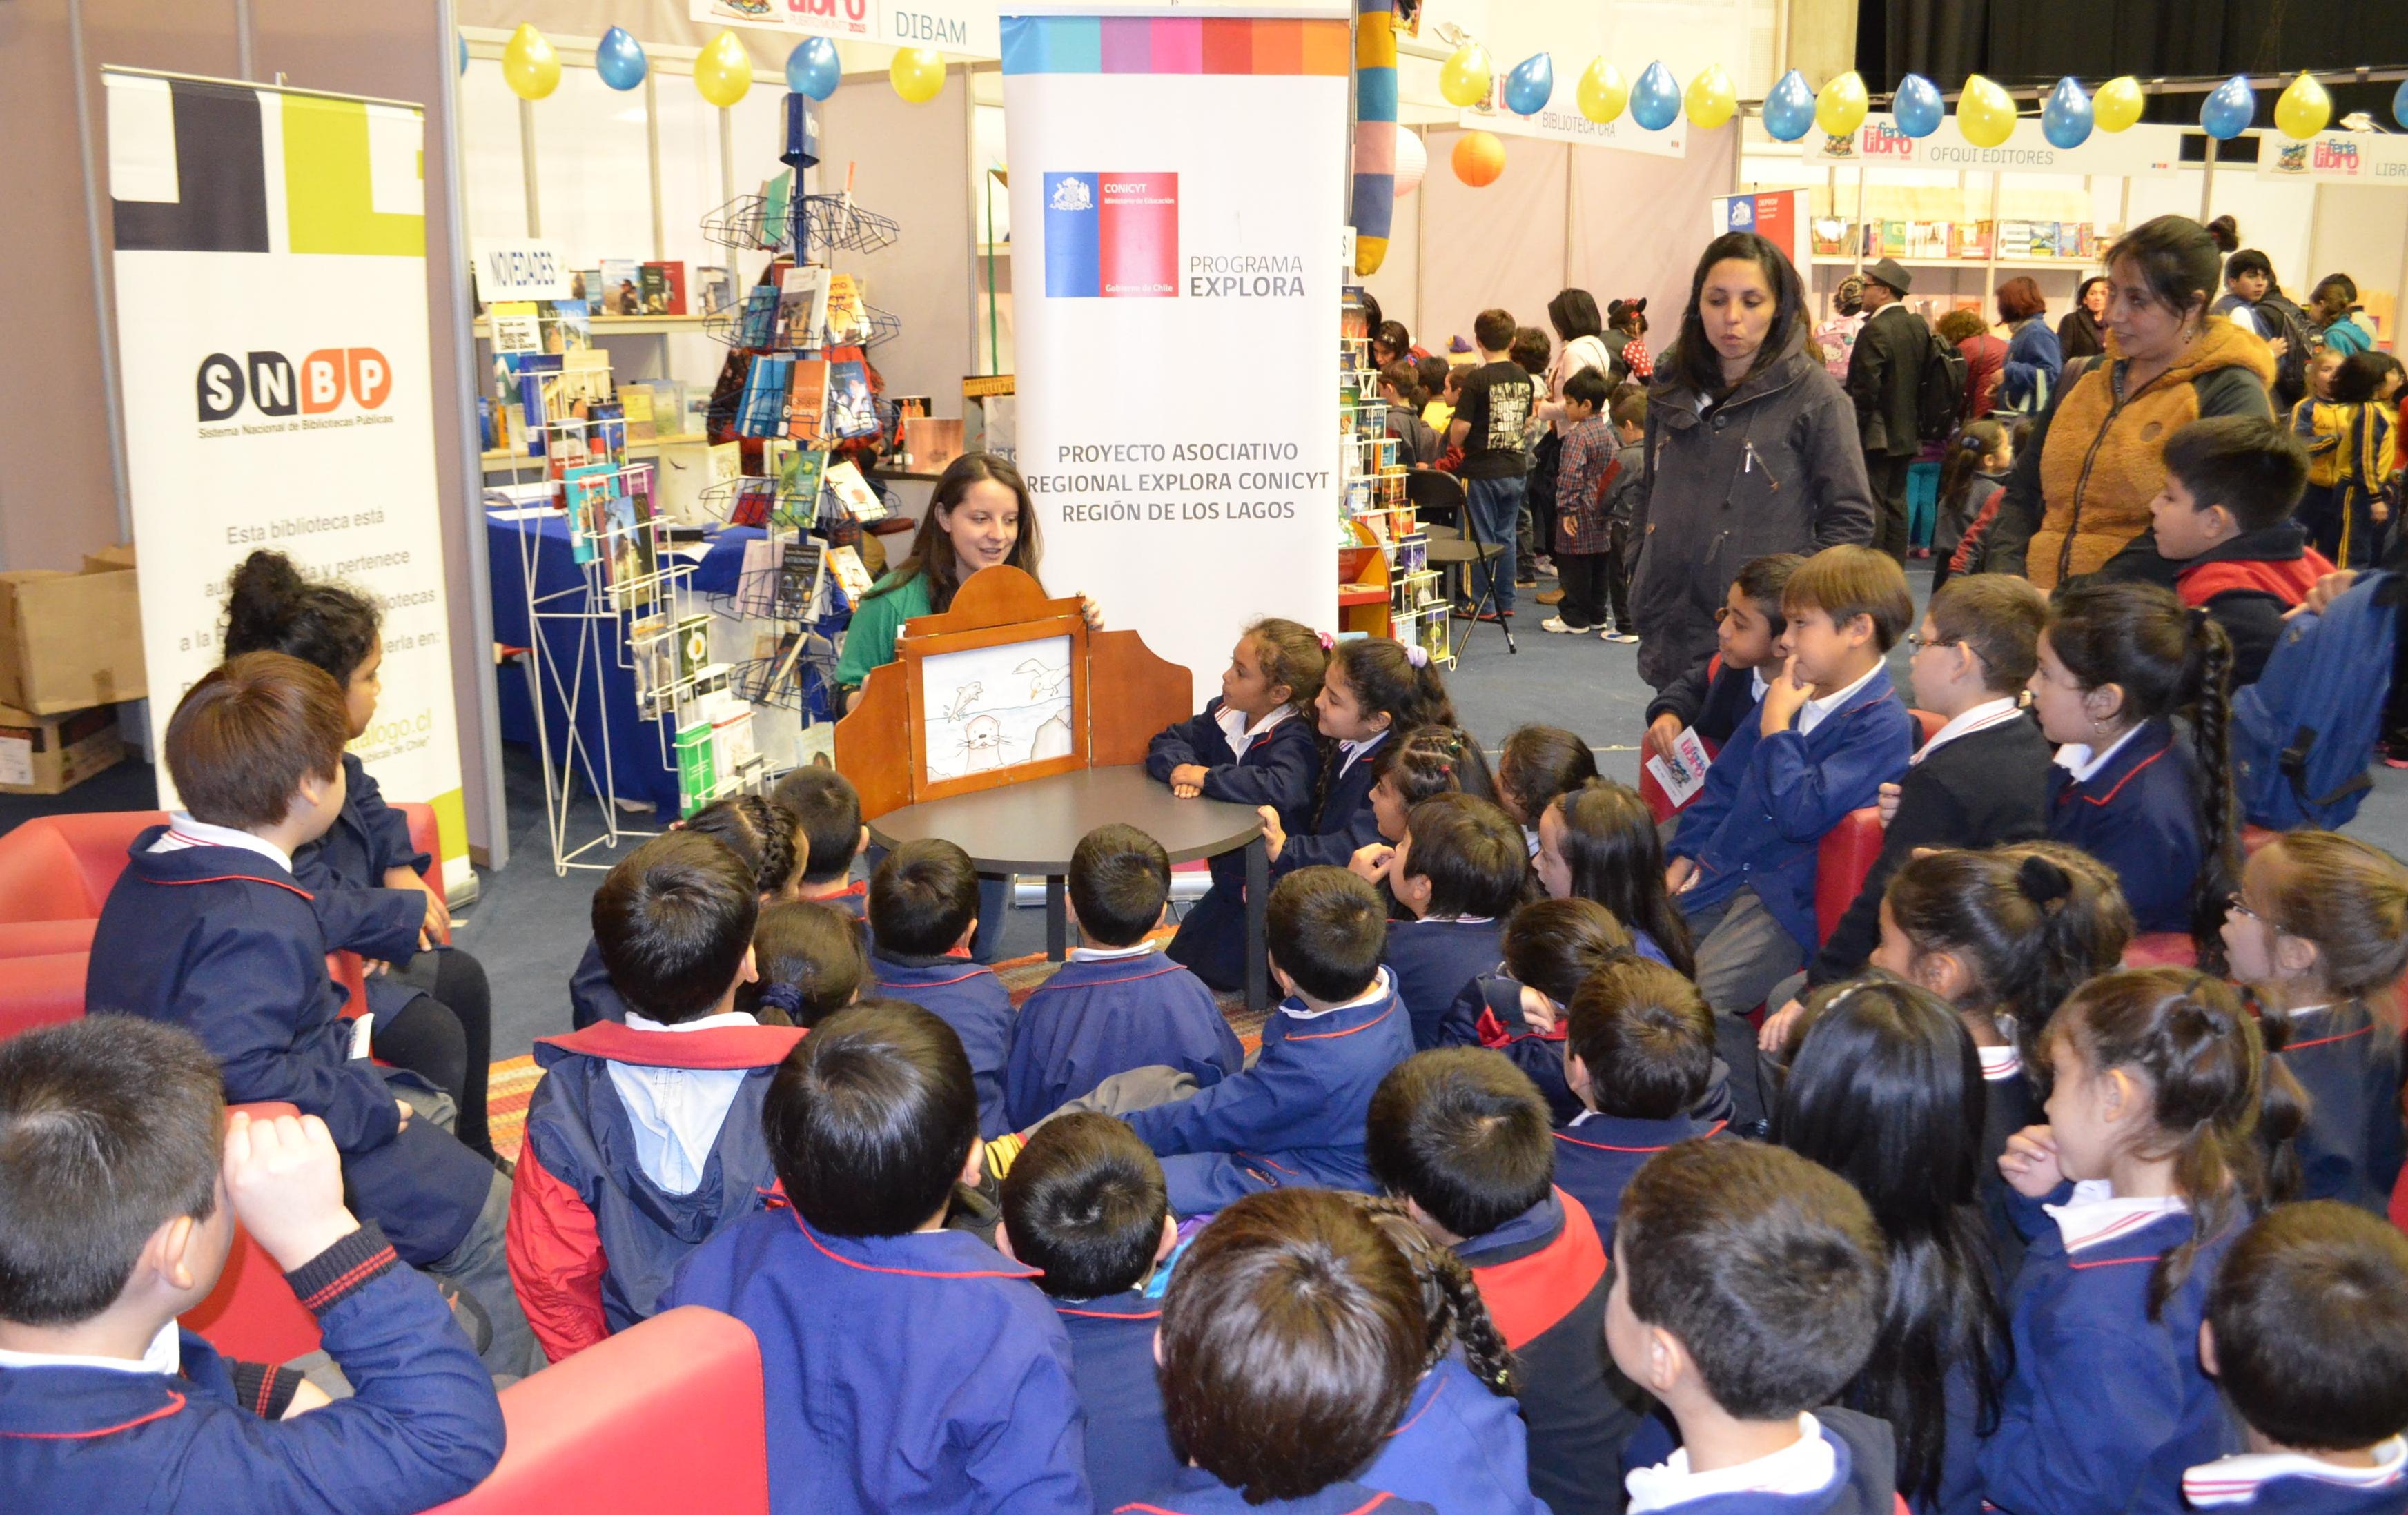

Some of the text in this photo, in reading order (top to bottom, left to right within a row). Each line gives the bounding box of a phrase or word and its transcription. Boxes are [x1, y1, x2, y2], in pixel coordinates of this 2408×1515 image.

[896, 11, 966, 45] DIBAM
[1542, 112, 1595, 135] BIBLIOTECA
[1877, 121, 1908, 139] feri
[1930, 146, 2054, 165] OFQUI EDITORES
[2327, 137, 2357, 155] feria
[2375, 162, 2408, 177] LIBR
[1104, 183, 1146, 193] CONICYT
[1144, 197, 1175, 205] Educación
[489, 251, 555, 286] NOVEDADES
[1190, 256, 1303, 273] PROGRAMA
[1106, 284, 1173, 293] Gobierno de Chile
[1190, 277, 1305, 297] EXPLORA
[202, 353, 388, 416] SNBP
[199, 414, 394, 438] Sistema Nacional de Bibliotecas Públicas
[1058, 442, 1298, 462] PROYECTO ASOCIATIVO
[1027, 471, 1329, 493] REGIONAL EXPLORA CONICYT
[1062, 500, 1295, 522] REGIÓN DE LOS LAGOS
[228, 508, 385, 545] Esta biblioteca está
[323, 550, 410, 580] y pertenece
[179, 636, 191, 652] a
[195, 631, 211, 648] la
